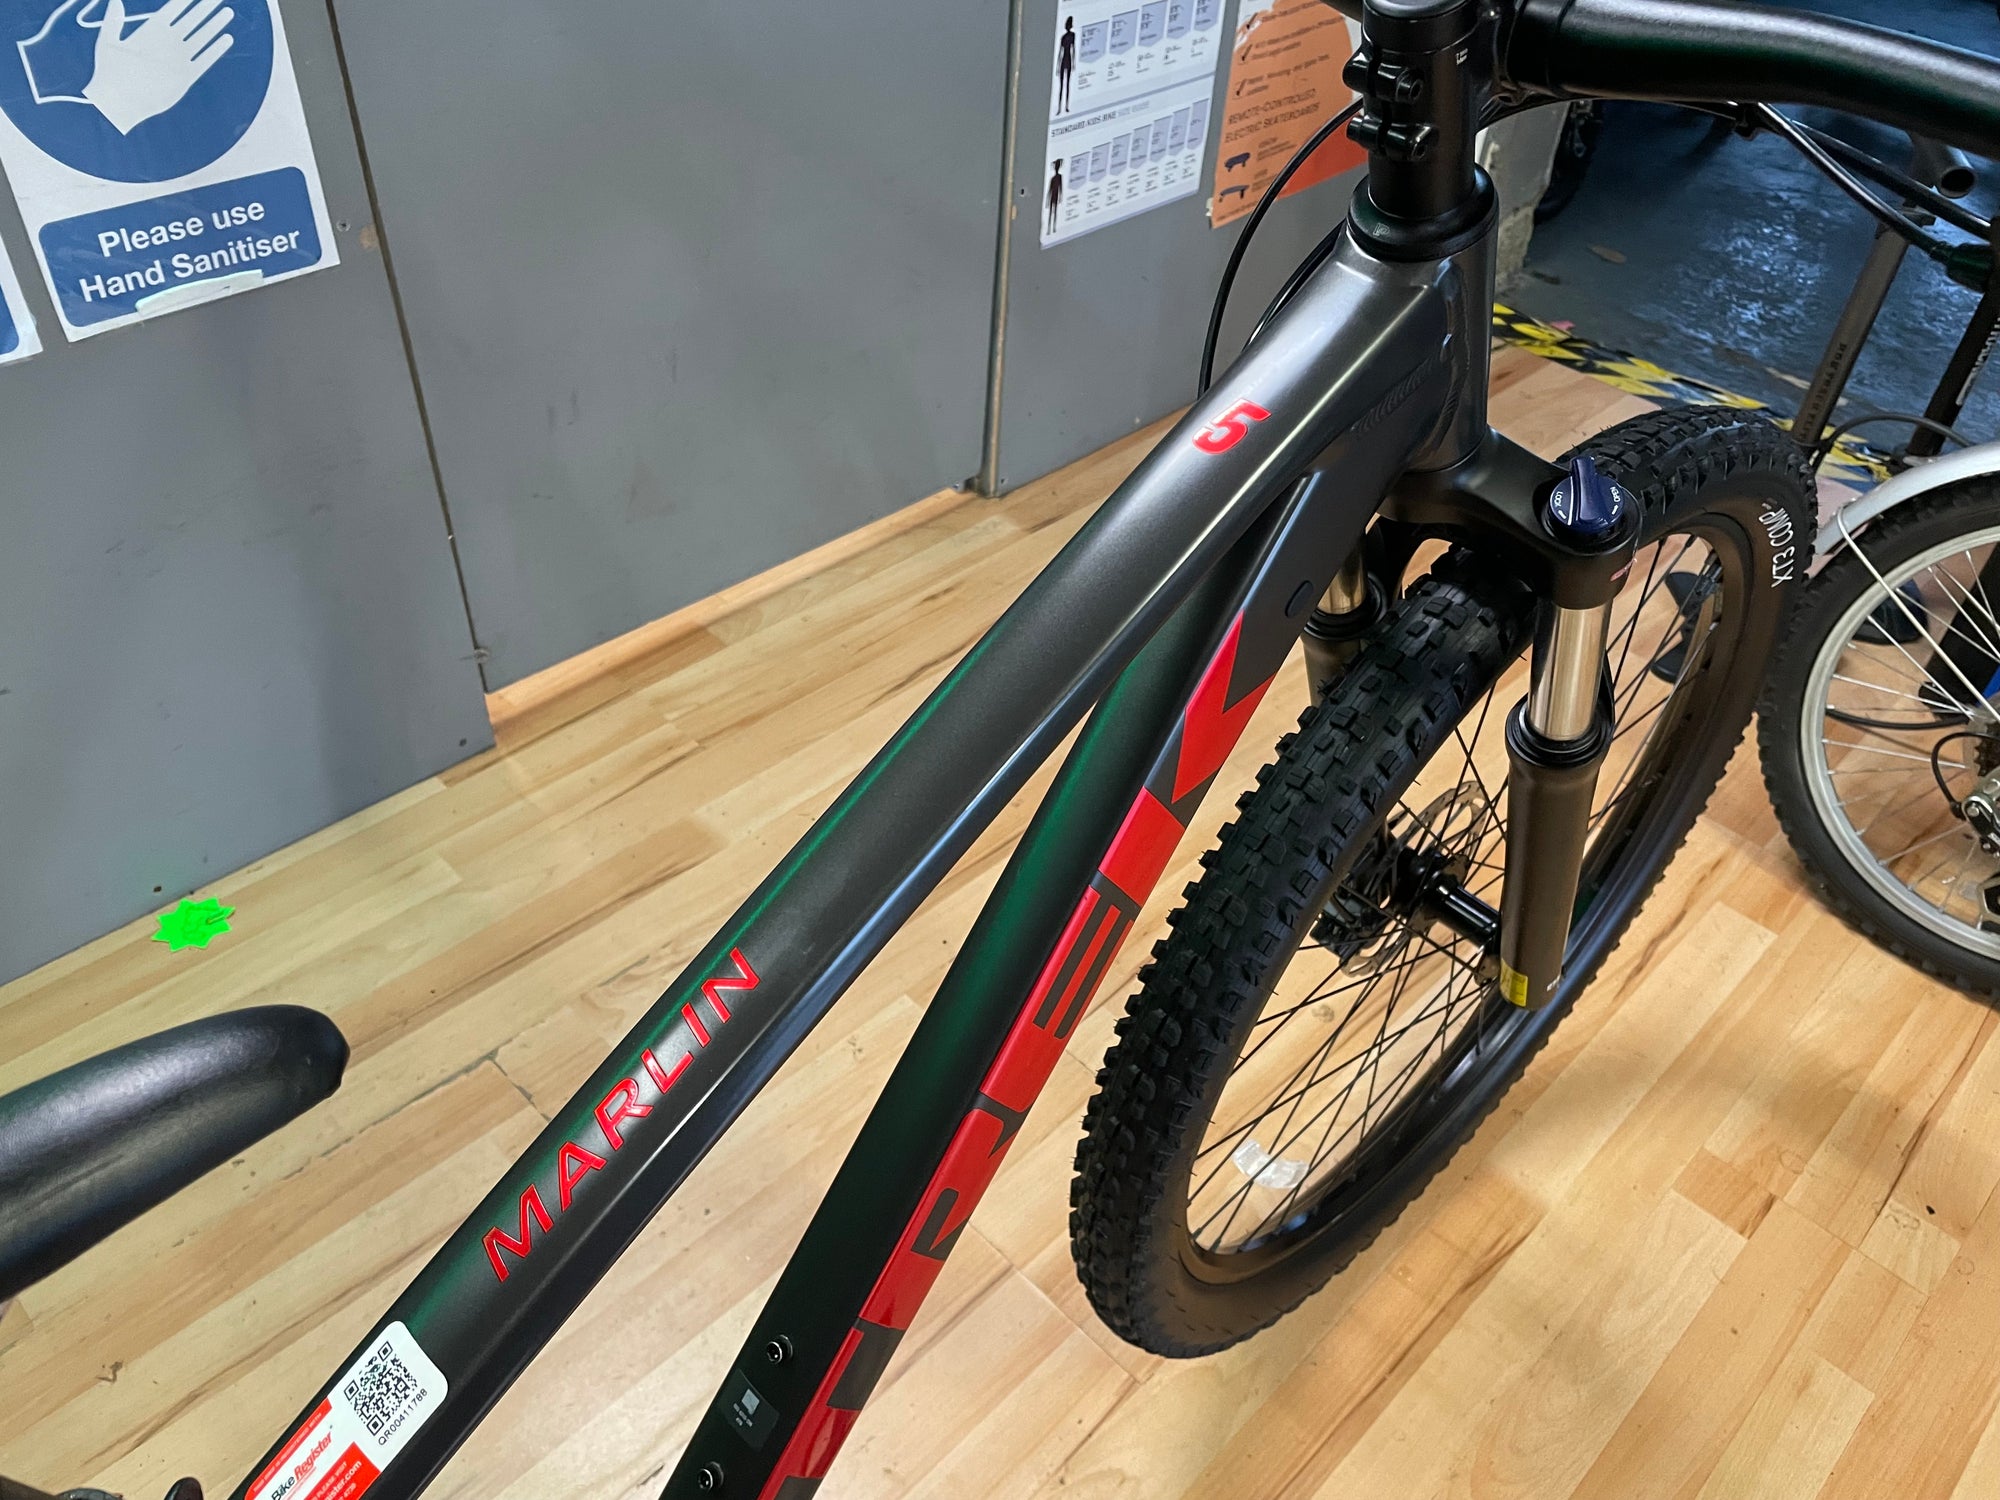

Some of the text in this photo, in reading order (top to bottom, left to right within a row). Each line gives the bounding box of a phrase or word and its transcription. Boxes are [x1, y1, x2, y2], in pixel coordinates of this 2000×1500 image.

[97, 201, 265, 258] Please use
[79, 230, 300, 302] Hand Sanitiser
[1192, 398, 1272, 455] 5
[1553, 491, 1564, 507] LOCK
[1758, 507, 1795, 588] XT3 COMP
[482, 946, 761, 1283] MARLIN
[378, 1388, 428, 1446] QR00411788
